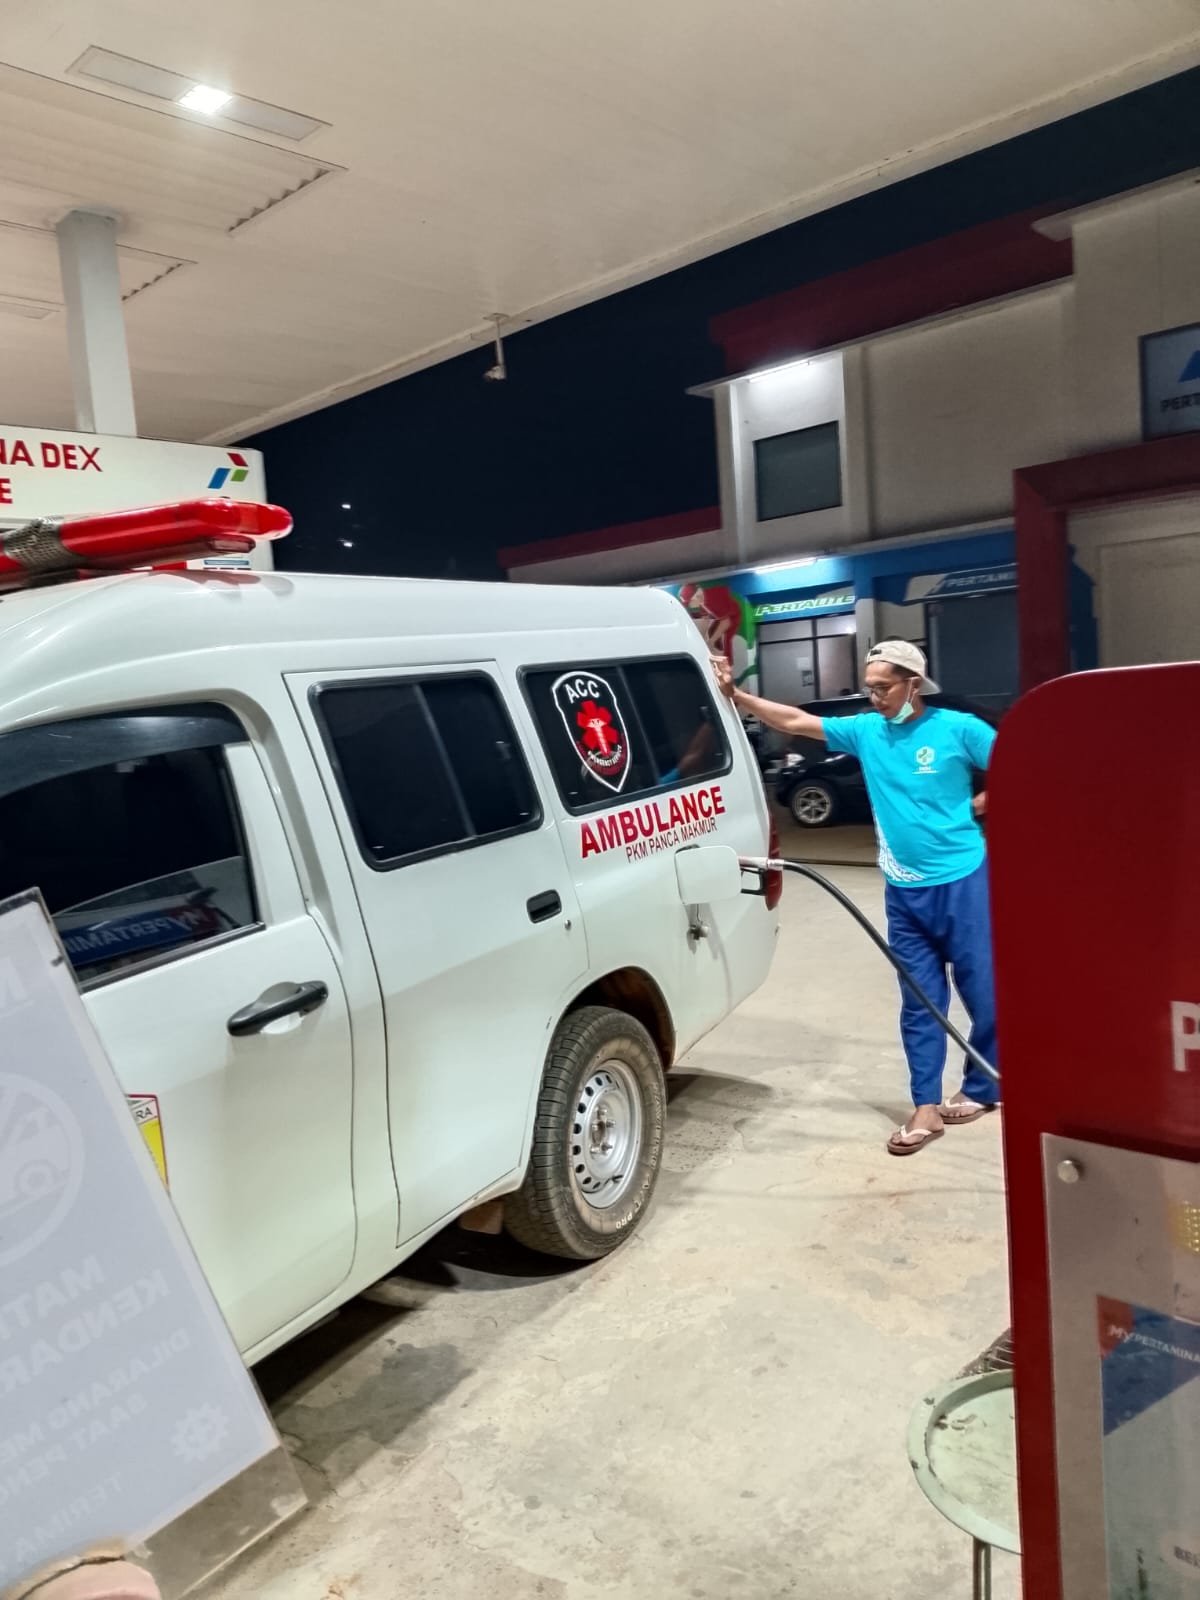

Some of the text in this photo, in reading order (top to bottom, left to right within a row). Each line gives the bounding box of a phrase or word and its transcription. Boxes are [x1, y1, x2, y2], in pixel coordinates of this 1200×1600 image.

[40, 441, 103, 473] DEX
[755, 595, 856, 617] PERTALITE
[564, 678, 600, 704] ACC
[580, 786, 726, 858] AMBULANCE
[626, 816, 718, 863] PKM PANCA MAKMUR
[615, 1211, 634, 1230] PRO
